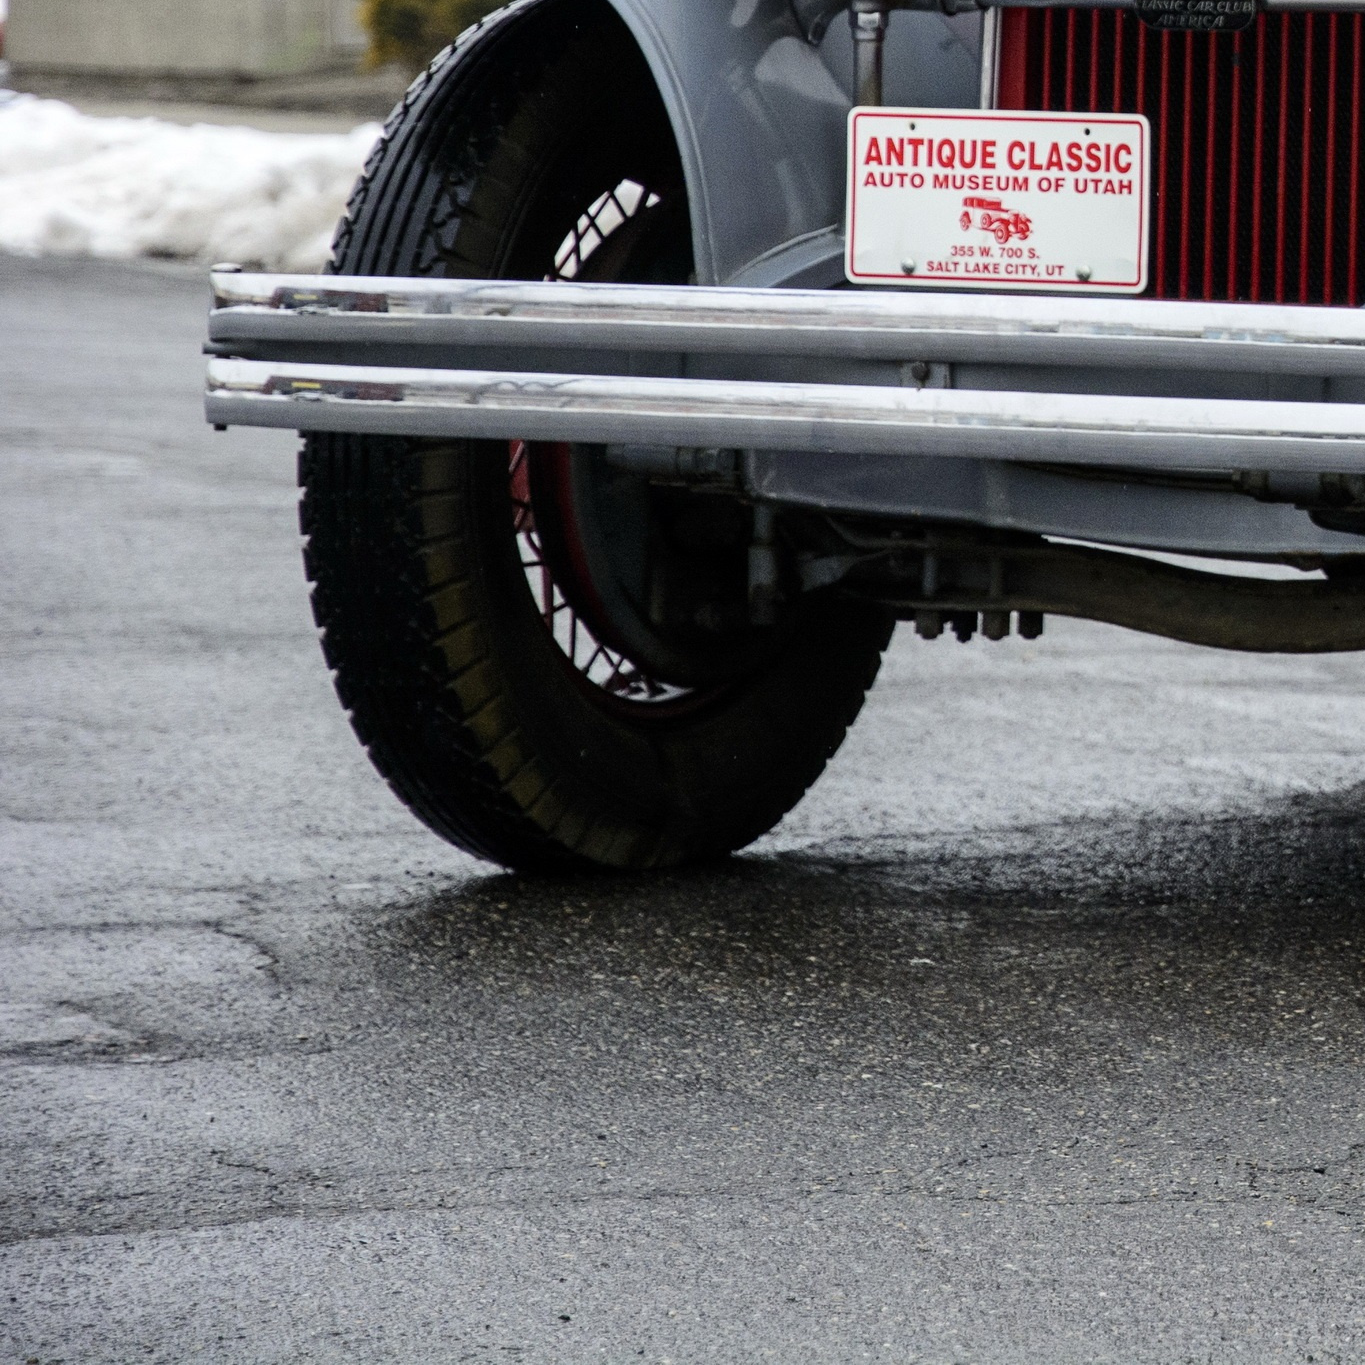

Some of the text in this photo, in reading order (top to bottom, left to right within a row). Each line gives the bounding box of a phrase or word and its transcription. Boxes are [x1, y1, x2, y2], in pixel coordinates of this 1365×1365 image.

[1186, 0, 1217, 13] CAR
[1216, 0, 1252, 13] CLUB
[1155, 14, 1225, 28] AMERICA
[864, 137, 1132, 174] ANTIQUE CLASSIC
[864, 172, 1132, 195] AUTO MUSEUM OF UTAH
[950, 245, 1040, 260] 355 W. 700 S.
[926, 260, 1064, 277] SALT LAKE CITY, UT
